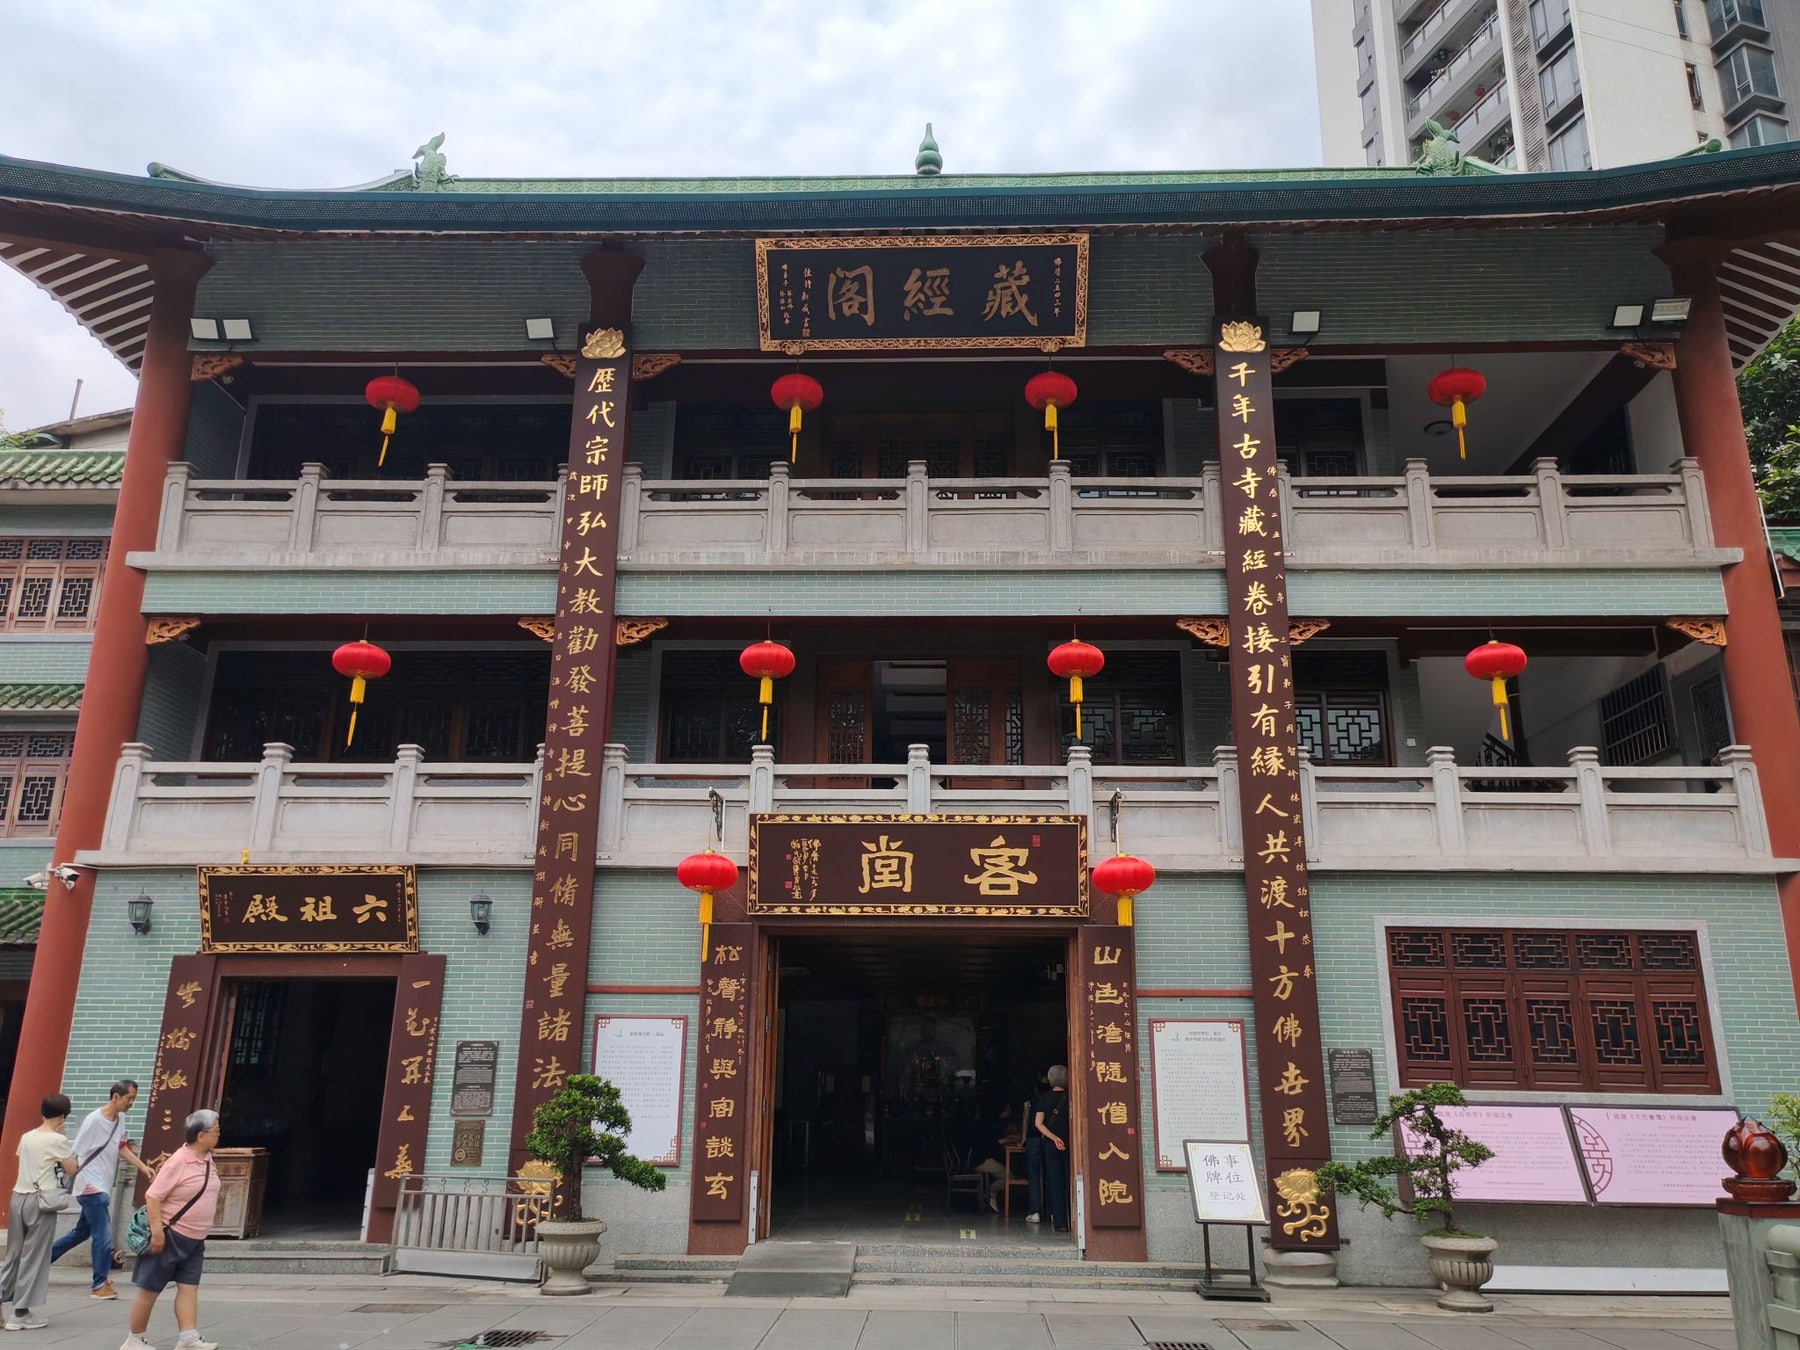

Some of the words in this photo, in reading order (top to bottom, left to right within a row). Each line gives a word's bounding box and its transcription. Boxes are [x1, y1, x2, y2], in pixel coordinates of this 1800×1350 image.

[827, 260, 1039, 328] 藏經閣
[858, 834, 1039, 897] 客堂
[241, 894, 389, 924] 六祖殿
[1202, 1153, 1240, 1168] 佛事
[1206, 1170, 1244, 1184] 牌位
[1209, 1191, 1247, 1201] 登记处
